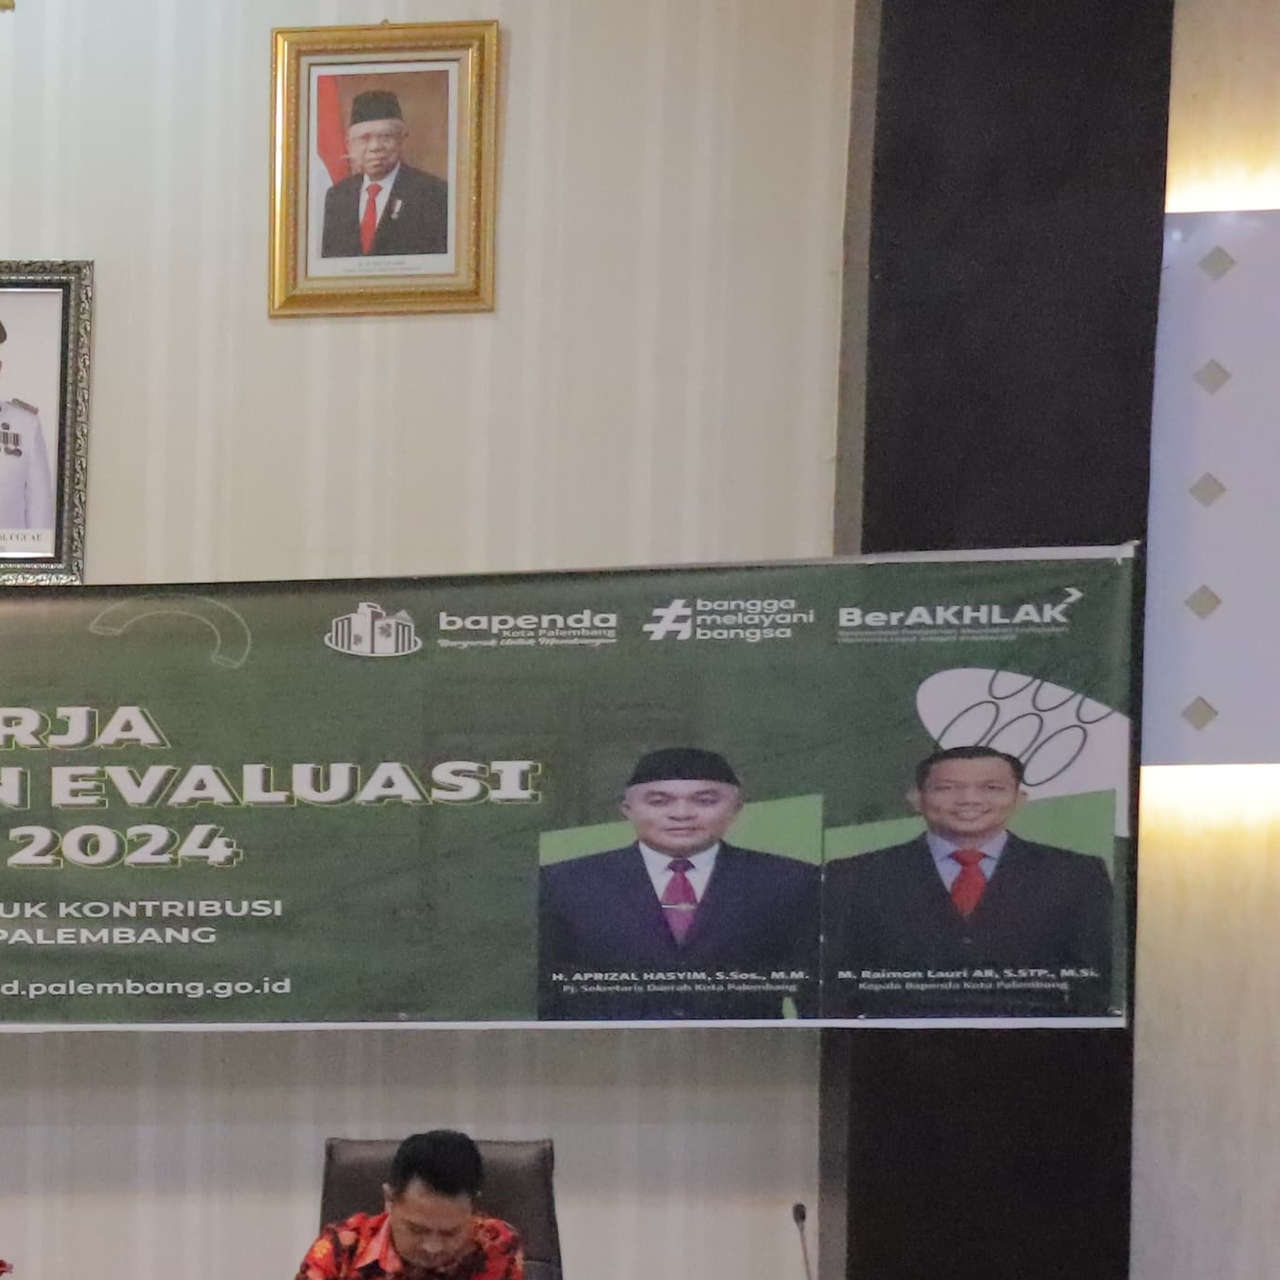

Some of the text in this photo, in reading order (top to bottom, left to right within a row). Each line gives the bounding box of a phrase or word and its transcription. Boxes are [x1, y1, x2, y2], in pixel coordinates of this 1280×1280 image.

[696, 599, 796, 612] bangga
[439, 609, 617, 633] bapenda
[696, 610, 814, 625] melayani
[839, 604, 1068, 627] BerAKHLAK
[502, 628, 616, 639] Kota Palembang
[696, 627, 792, 643] bangsa
[50, 760, 542, 807] EVALUASI
[7, 823, 244, 868] 2024
[58, 899, 282, 918] KONTRIBUSI
[552, 973, 568, 981] H.
[572, 972, 639, 981] APRIZAL
[643, 972, 712, 982] HASYIM,
[770, 971, 810, 980] M.M.
[838, 970, 857, 979] M.
[861, 969, 922, 979] Raimon
[927, 968, 967, 978] Lauri
